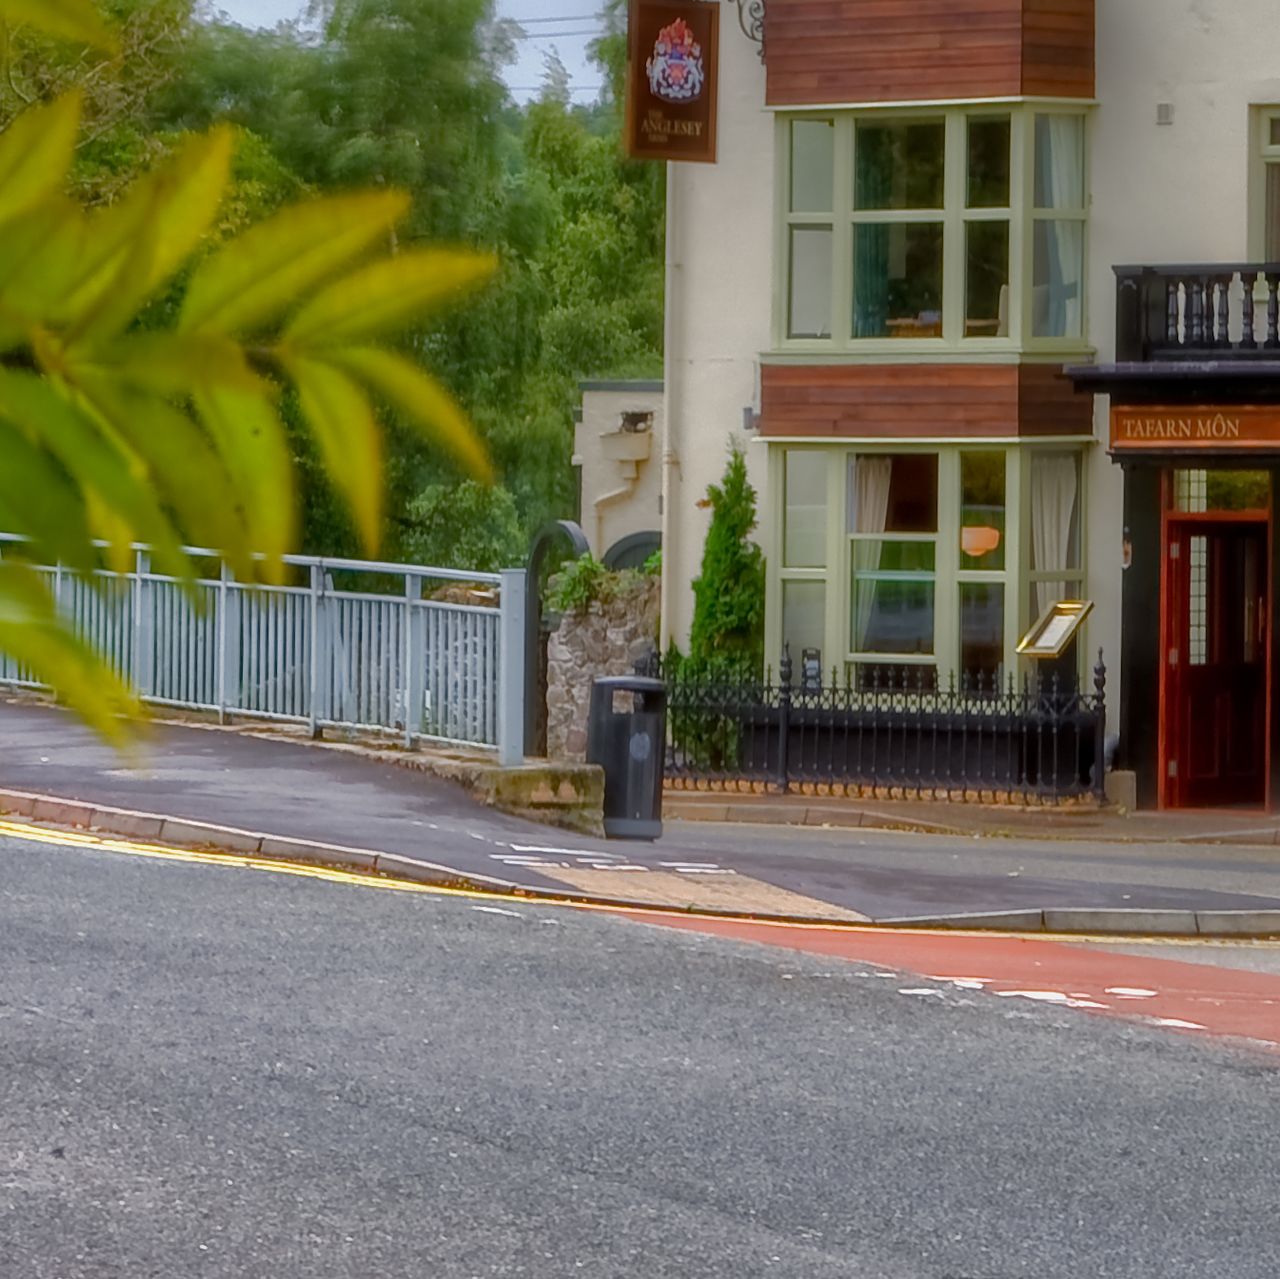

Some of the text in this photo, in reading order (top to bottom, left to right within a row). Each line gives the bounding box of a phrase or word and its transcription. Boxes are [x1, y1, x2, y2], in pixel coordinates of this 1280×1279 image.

[641, 119, 702, 136] ANGLESEY
[1122, 412, 1240, 438] TAFARN MÔN
